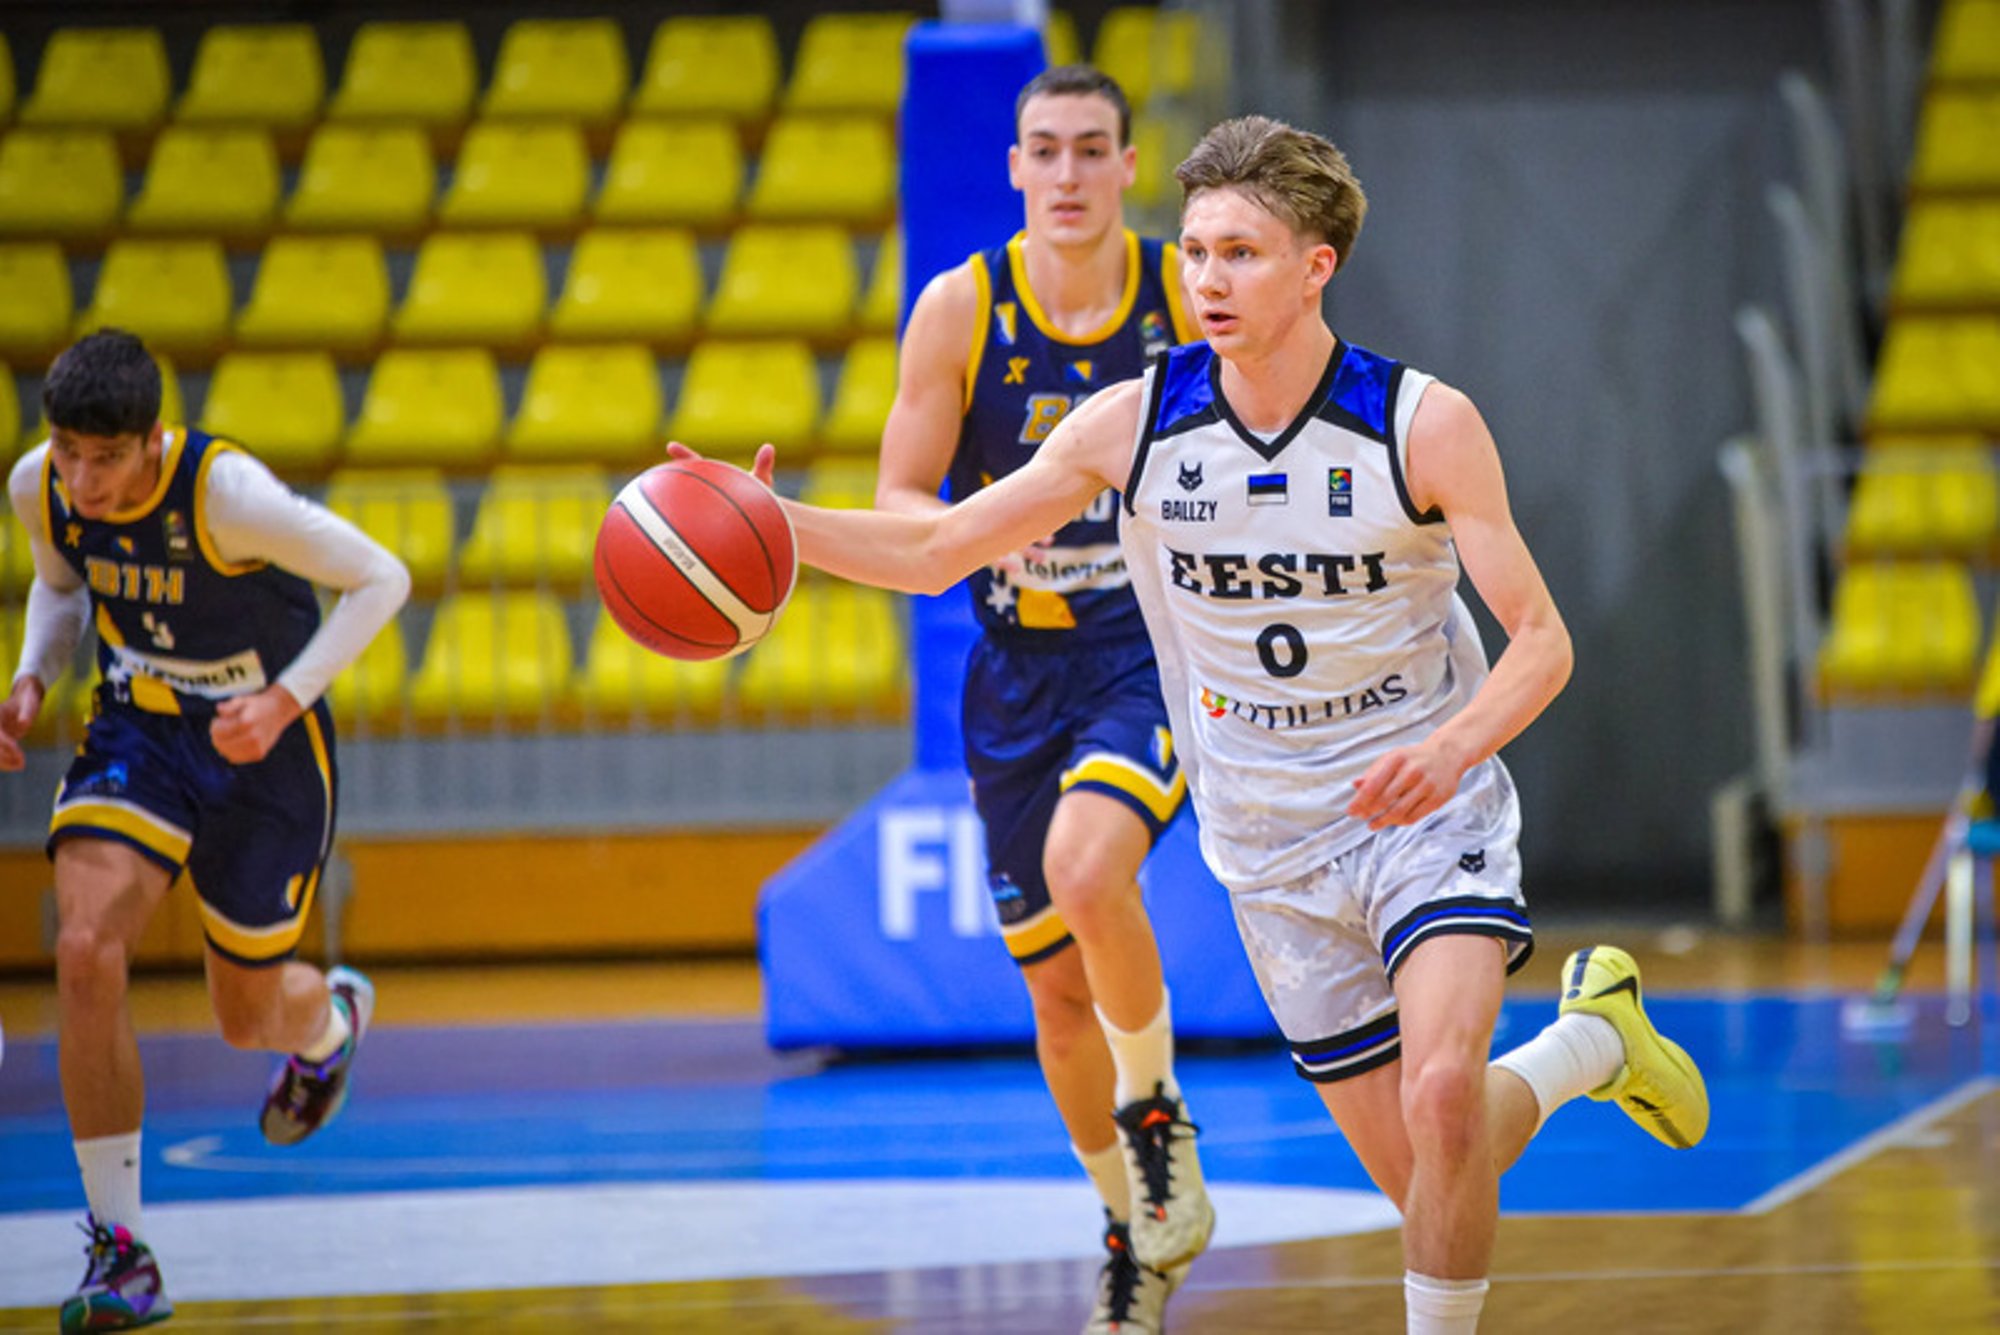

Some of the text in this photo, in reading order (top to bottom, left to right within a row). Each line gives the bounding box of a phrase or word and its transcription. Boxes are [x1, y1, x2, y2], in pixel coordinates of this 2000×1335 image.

[1161, 500, 1218, 522] BALLZY
[1166, 549, 1390, 600] EESTI
[1256, 622, 1308, 679] 0
